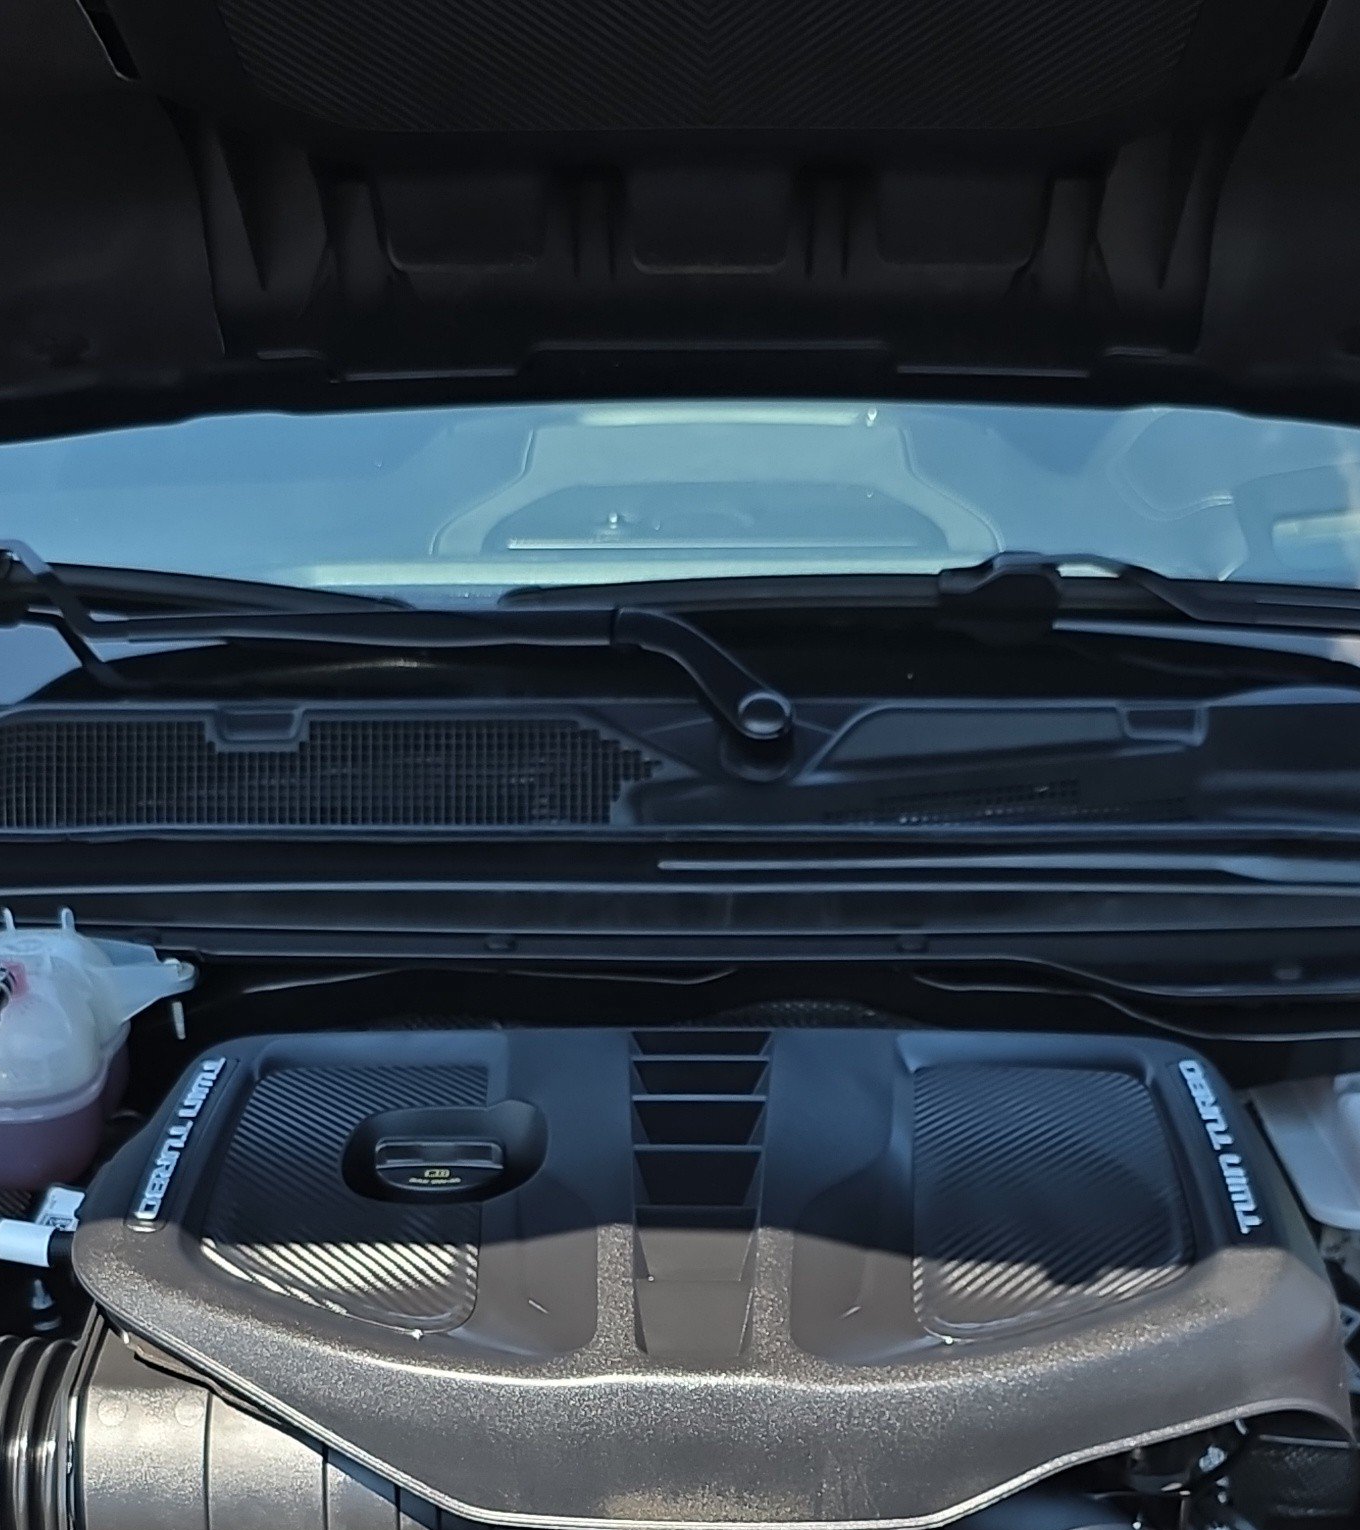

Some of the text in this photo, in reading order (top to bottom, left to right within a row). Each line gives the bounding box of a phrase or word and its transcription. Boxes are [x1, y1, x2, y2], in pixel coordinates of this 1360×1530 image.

[134, 1056, 226, 1220] TWIN TURBO
[1178, 1059, 1264, 1235] TWIN TURBO
